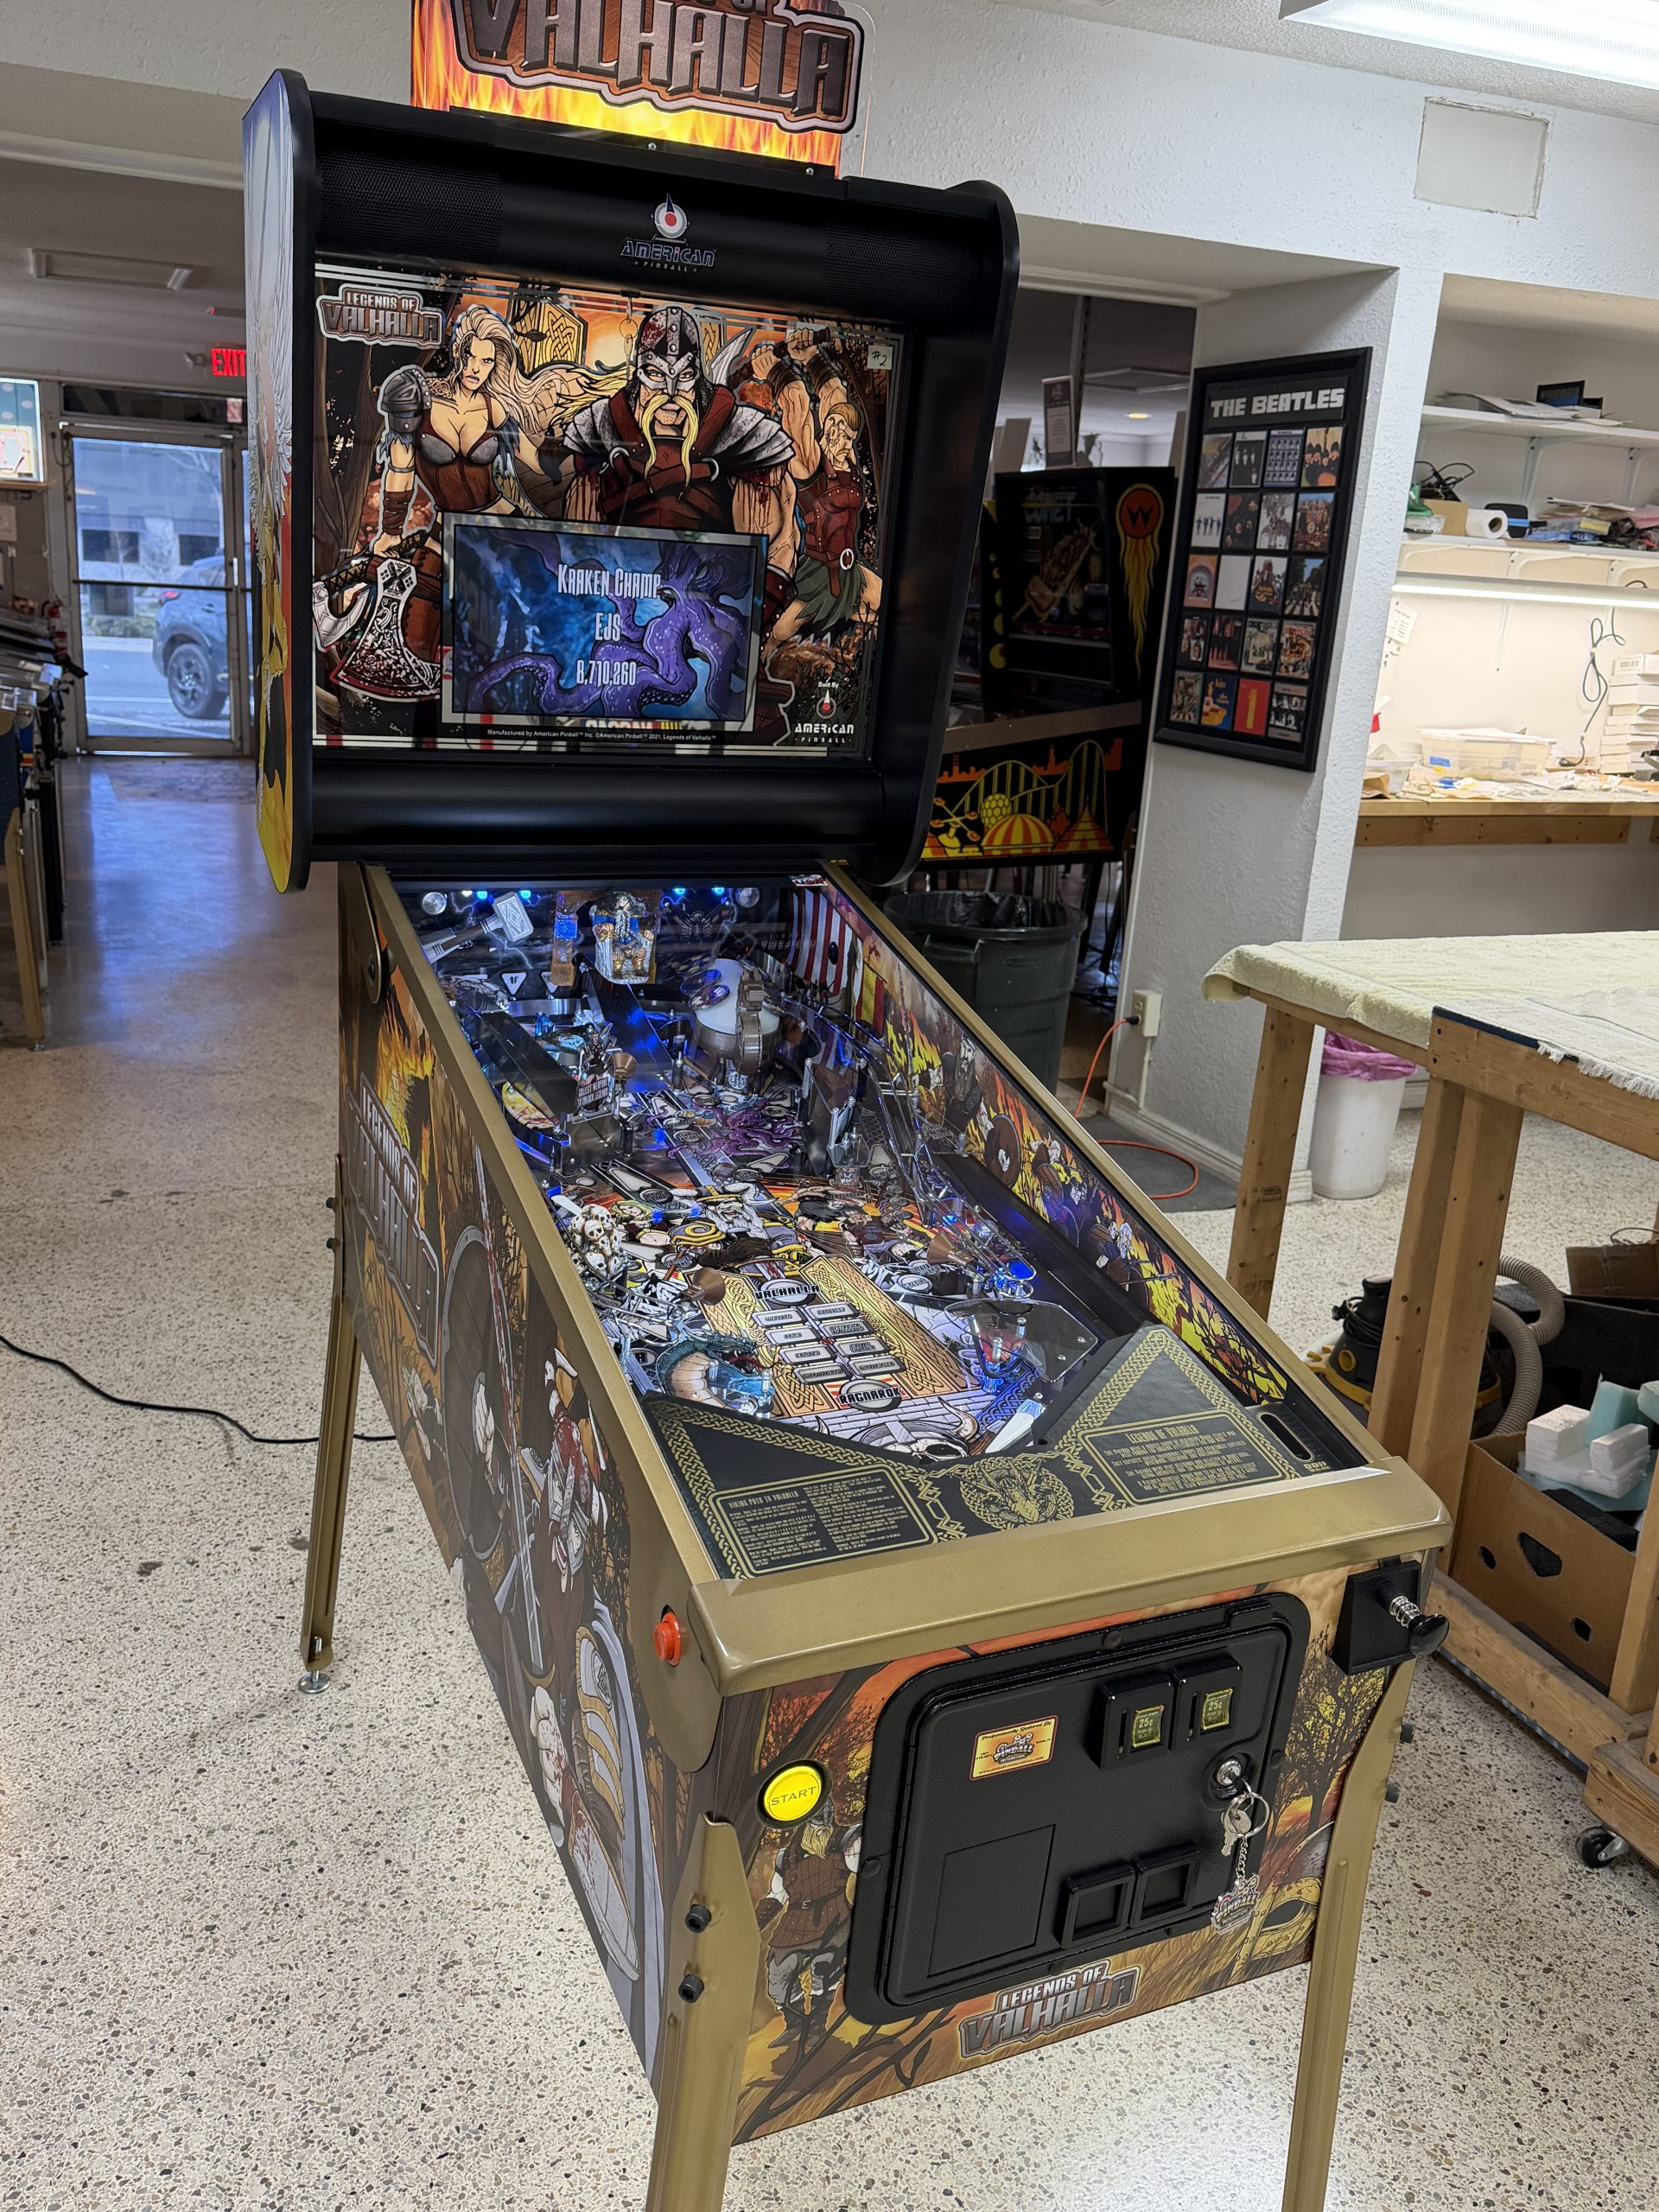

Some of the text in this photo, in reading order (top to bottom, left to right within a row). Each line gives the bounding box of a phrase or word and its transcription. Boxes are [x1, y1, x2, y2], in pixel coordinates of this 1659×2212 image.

[620, 240, 715, 267] AMERICAN
[643, 261, 688, 272] PINBALL
[346, 292, 416, 312] LEGENDS OF
[325, 304, 439, 341] VALHALLA
[211, 348, 247, 377] EXIT
[1211, 388, 1345, 418] THE BEATLES
[594, 612, 621, 641] EJS
[576, 659, 637, 687] 8,710,260
[794, 723, 855, 734] AMERICAN
[362, 1085, 416, 1208] LEGENDS OF
[753, 1285, 821, 1300] VALHALLA
[838, 1387, 902, 1404] RAGNAROK
[1125, 1431, 1159, 1444] LEGENDS
[1208, 1700, 1223, 1711] 25¢
[1138, 1717, 1154, 1728] 25¢
[771, 1786, 817, 1806] START
[1001, 1965, 1104, 2011] LEGENDS OF
[966, 1972, 1136, 2051] VALHALLA
